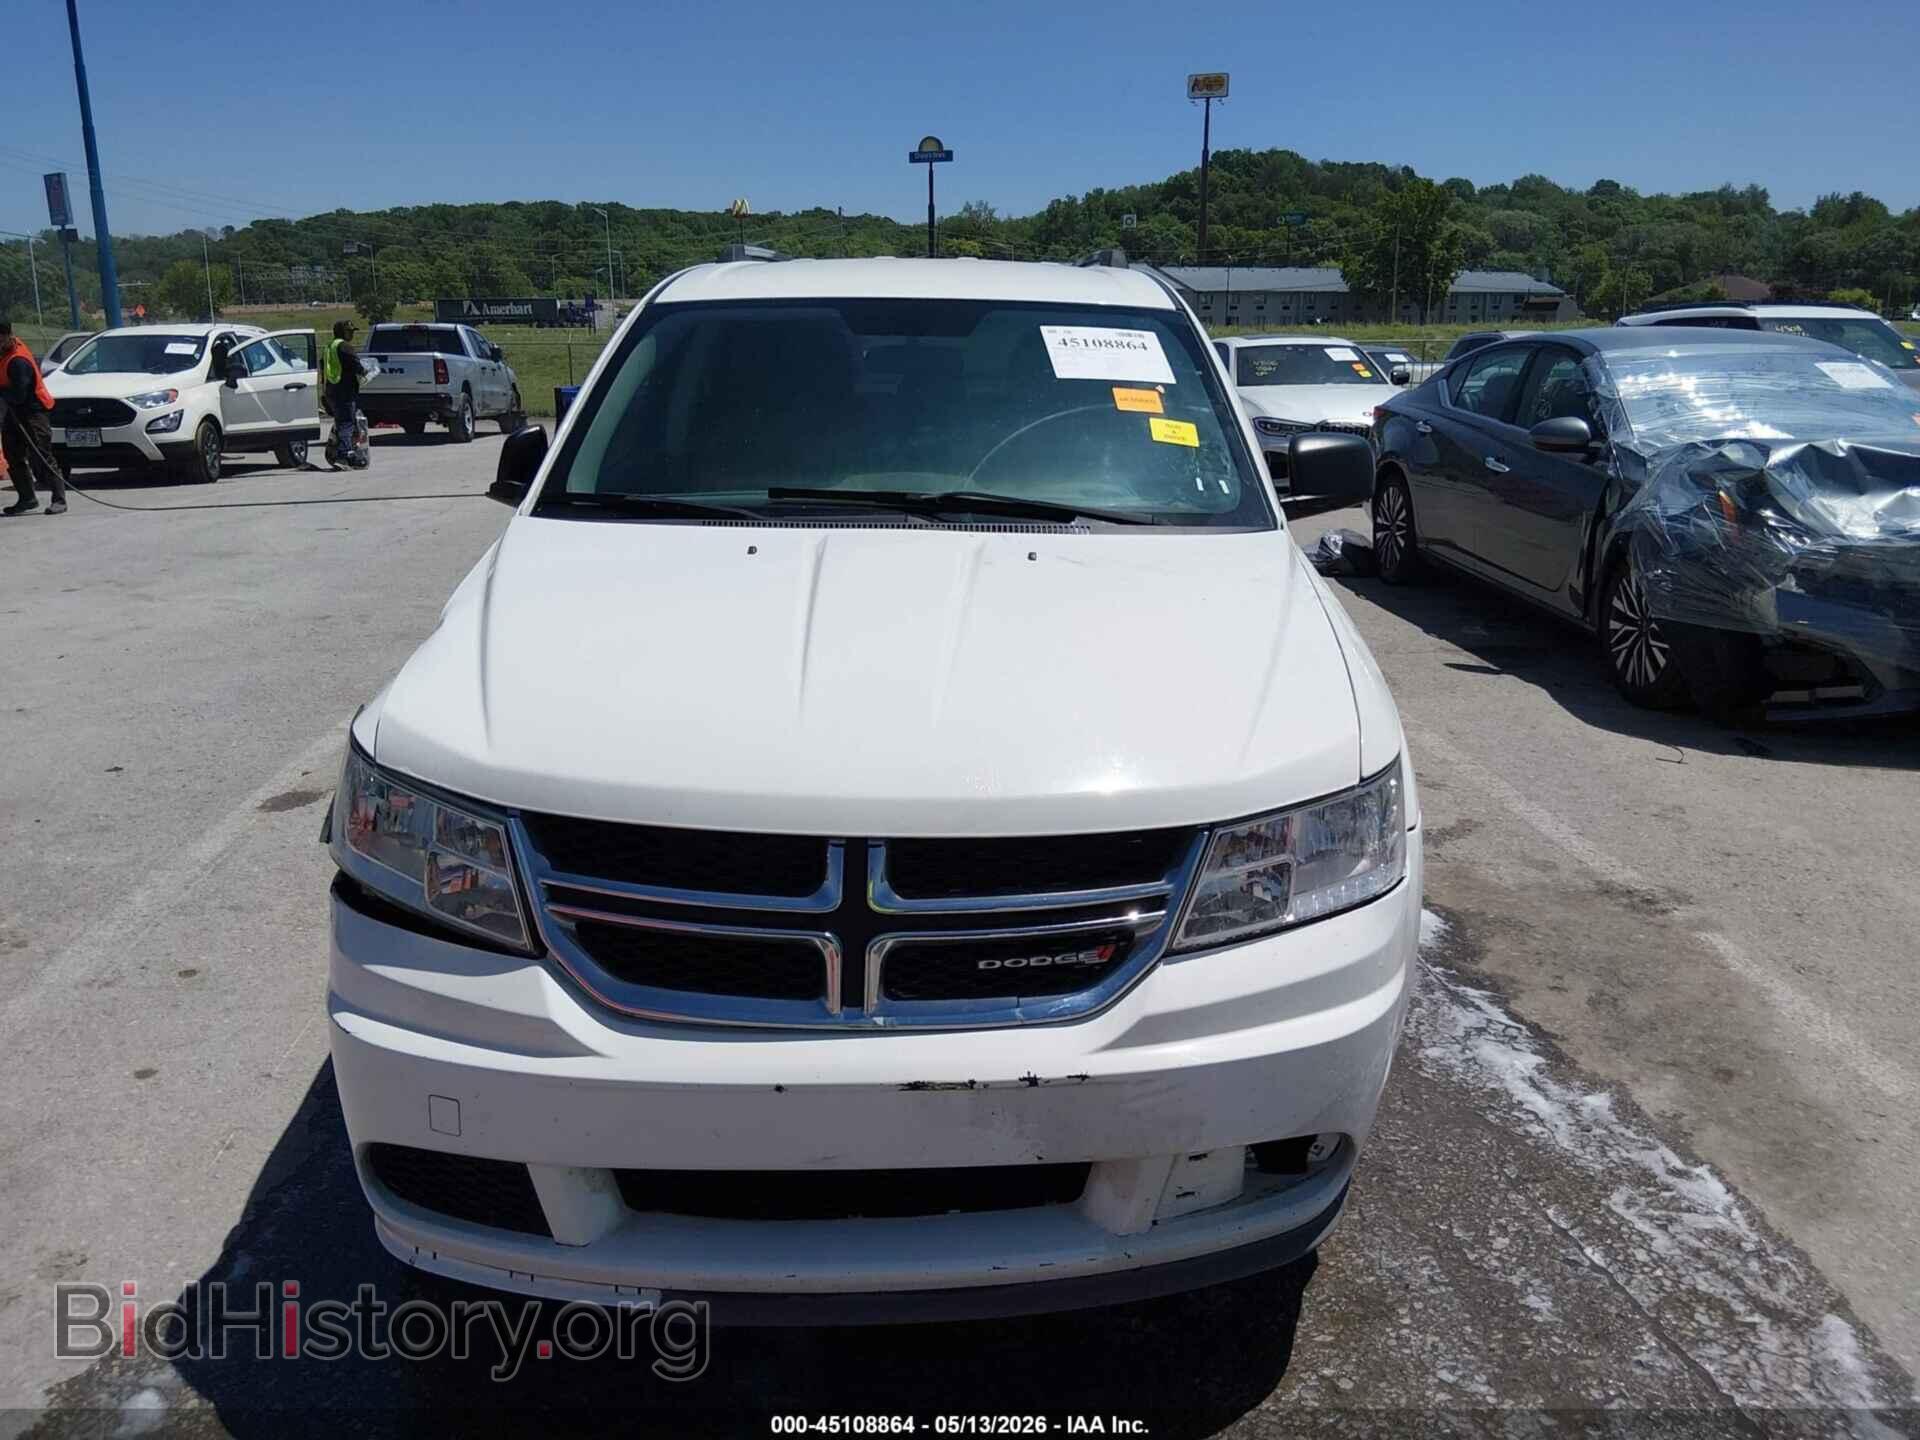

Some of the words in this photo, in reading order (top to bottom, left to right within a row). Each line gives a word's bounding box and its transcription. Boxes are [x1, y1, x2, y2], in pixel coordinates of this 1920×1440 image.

[481, 302, 533, 316] Amerhart
[1058, 337, 1148, 351] 45108864
[380, 367, 405, 375] AM
[978, 952, 1107, 969] DODGE
